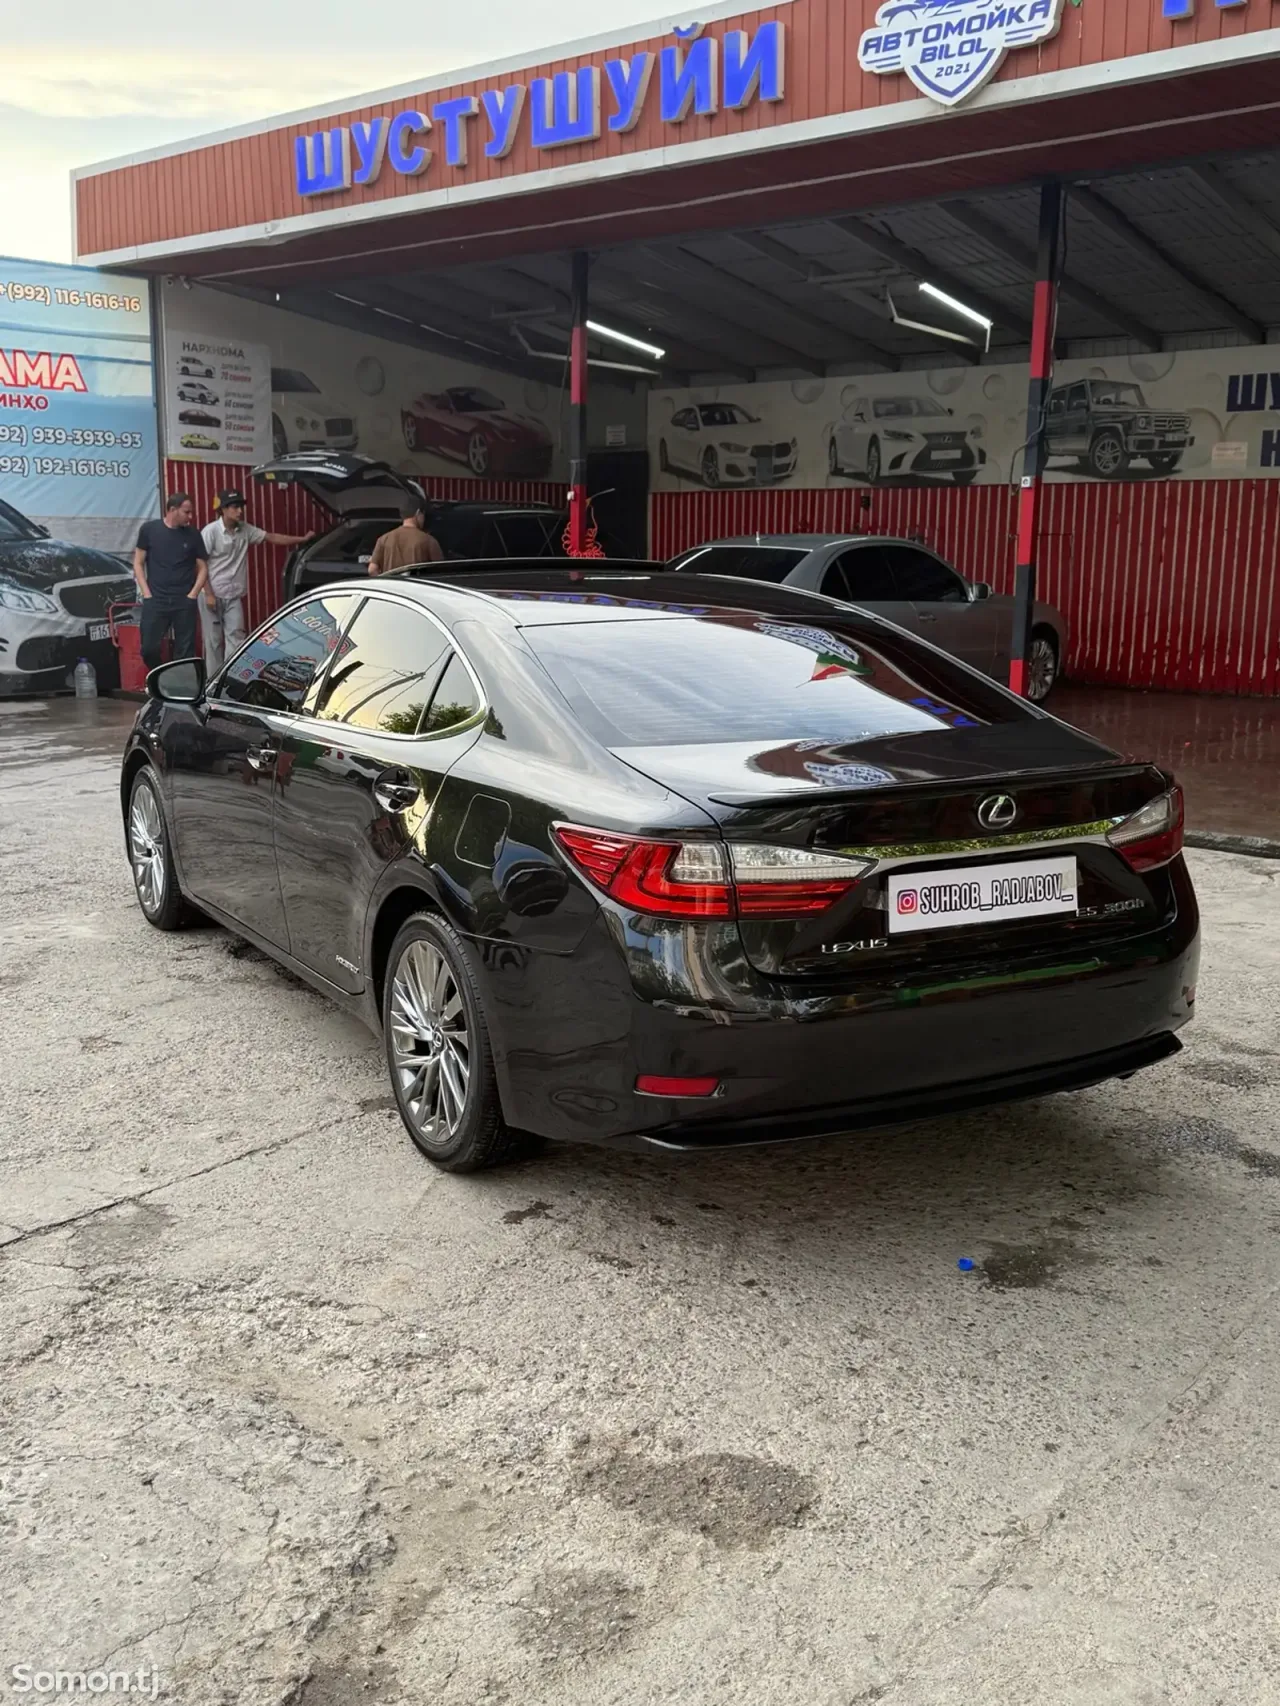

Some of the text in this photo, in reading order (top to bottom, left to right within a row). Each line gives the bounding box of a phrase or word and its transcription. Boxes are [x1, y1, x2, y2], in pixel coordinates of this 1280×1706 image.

[862, 0, 1050, 57] АВТОМОЙКА
[919, 37, 989, 64] BILOL
[935, 62, 971, 79] 2021
[294, 20, 786, 198] ШУСТУШУЙИ
[55, 288, 142, 312] 116-1616-16
[32, 427, 142, 448] 939-3939-93
[34, 458, 130, 477] 192-1616-16
[920, 873, 1074, 915] SUHROB_RADJABOV_
[1076, 898, 1145, 918] ES 300h
[821, 938, 888, 954] LEXUS
